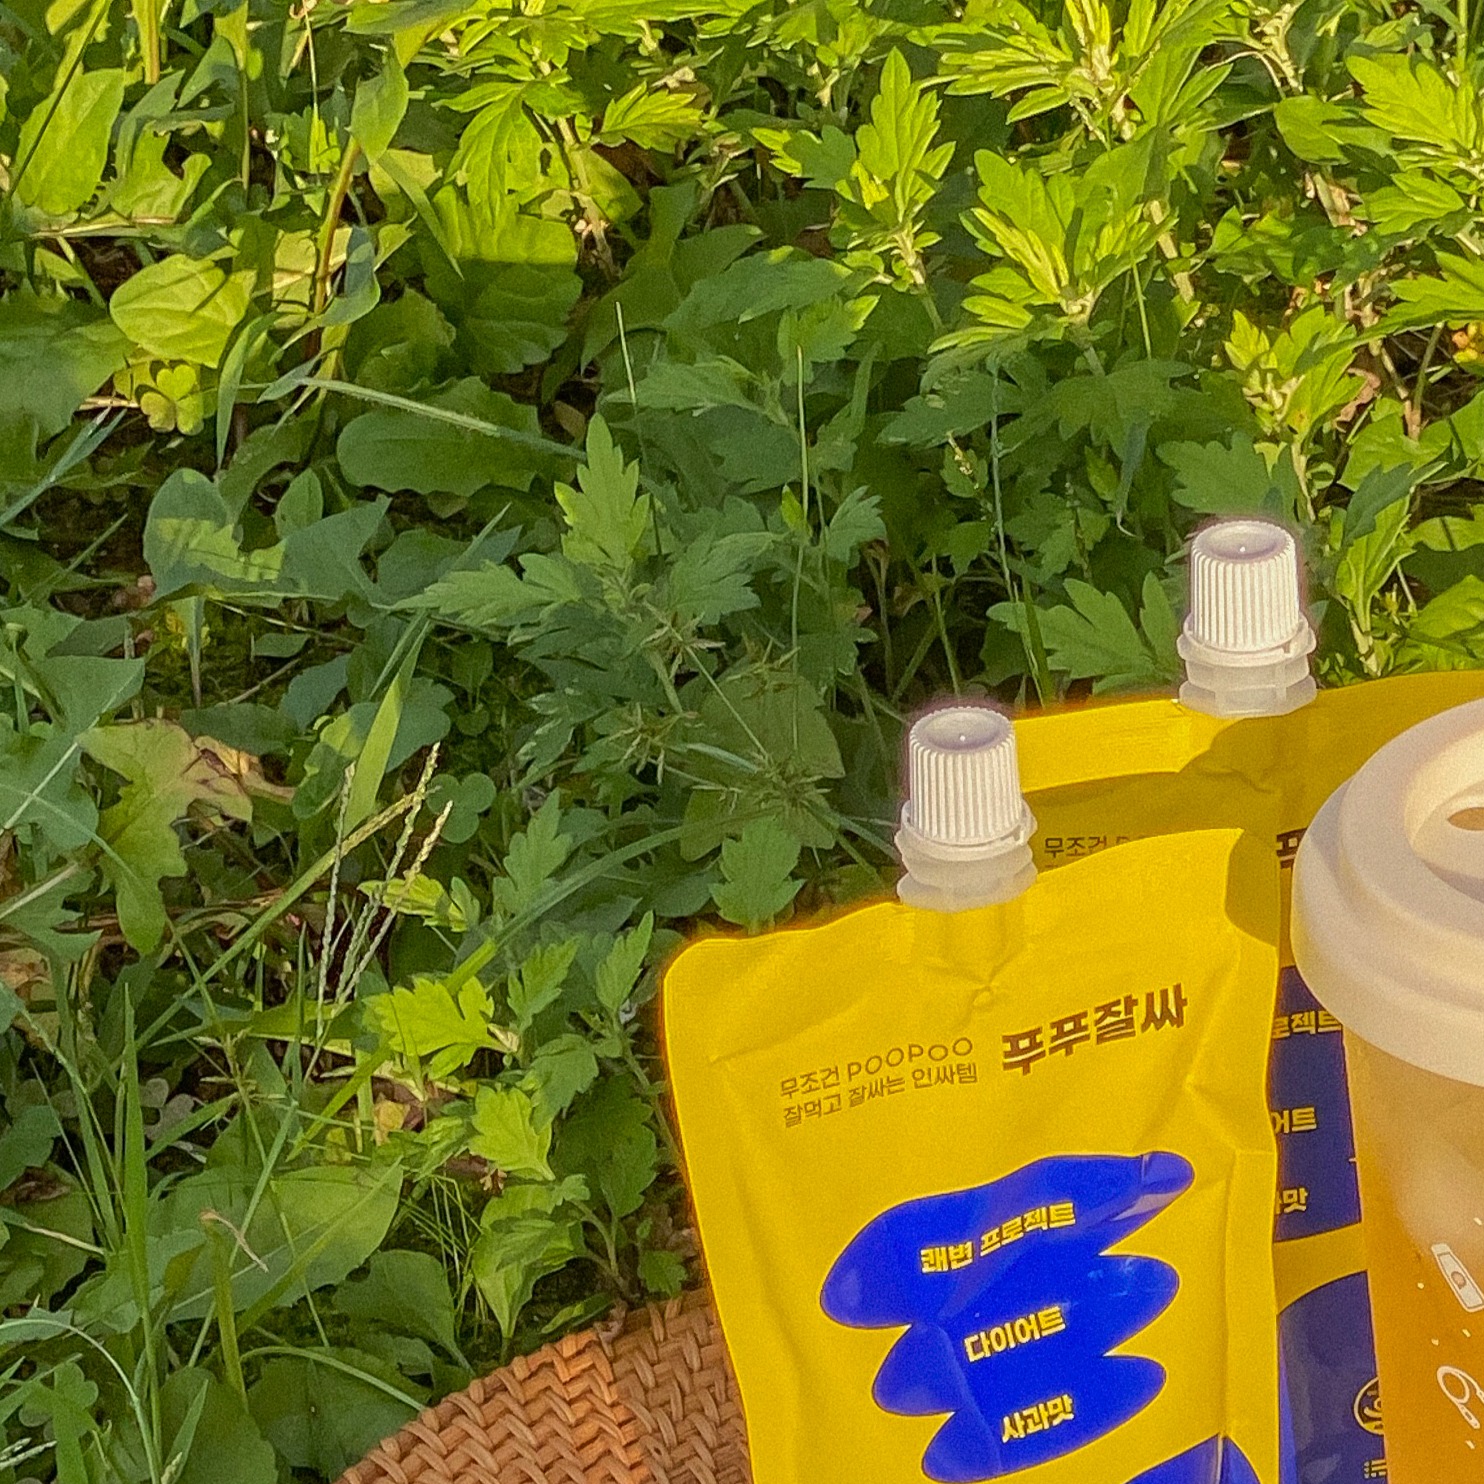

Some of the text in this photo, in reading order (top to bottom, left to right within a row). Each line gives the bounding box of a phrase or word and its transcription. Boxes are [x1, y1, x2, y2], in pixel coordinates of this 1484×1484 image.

[1001, 983, 1188, 1075] 푸푸잘싸
[1272, 1010, 1342, 1039] 로젝트
[780, 1037, 973, 1097] 무조건 POOPOO
[783, 1062, 978, 1128] 잘먹고 잘싸는 인싸템
[920, 1202, 1076, 1274] 쾌변 프로젝트
[964, 1305, 1066, 1362] 다이어트
[1002, 1394, 1075, 1443] 사과맛
